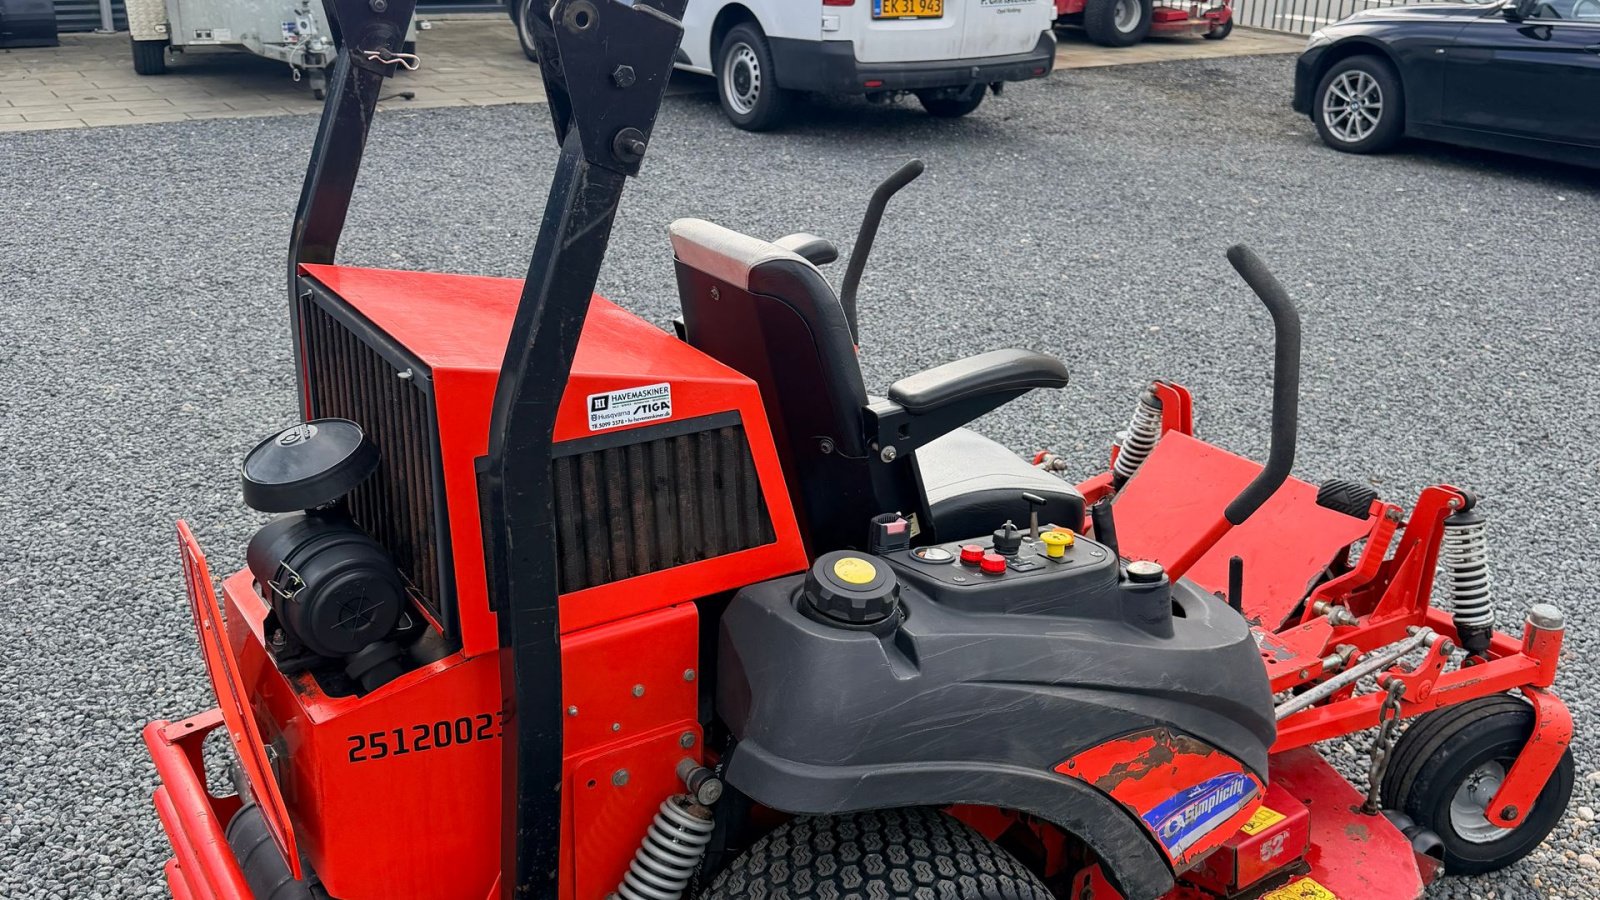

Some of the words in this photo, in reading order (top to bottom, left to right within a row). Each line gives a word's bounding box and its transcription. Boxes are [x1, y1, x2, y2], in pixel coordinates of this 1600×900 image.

[883, 0, 898, 13] EK
[902, 0, 915, 13] 31
[920, 0, 941, 12] 943
[612, 387, 669, 402] HAVEMASKINER
[633, 401, 670, 415] STIGA
[598, 410, 631, 421] Husqvarna
[1184, 778, 1245, 825] Simplicity
